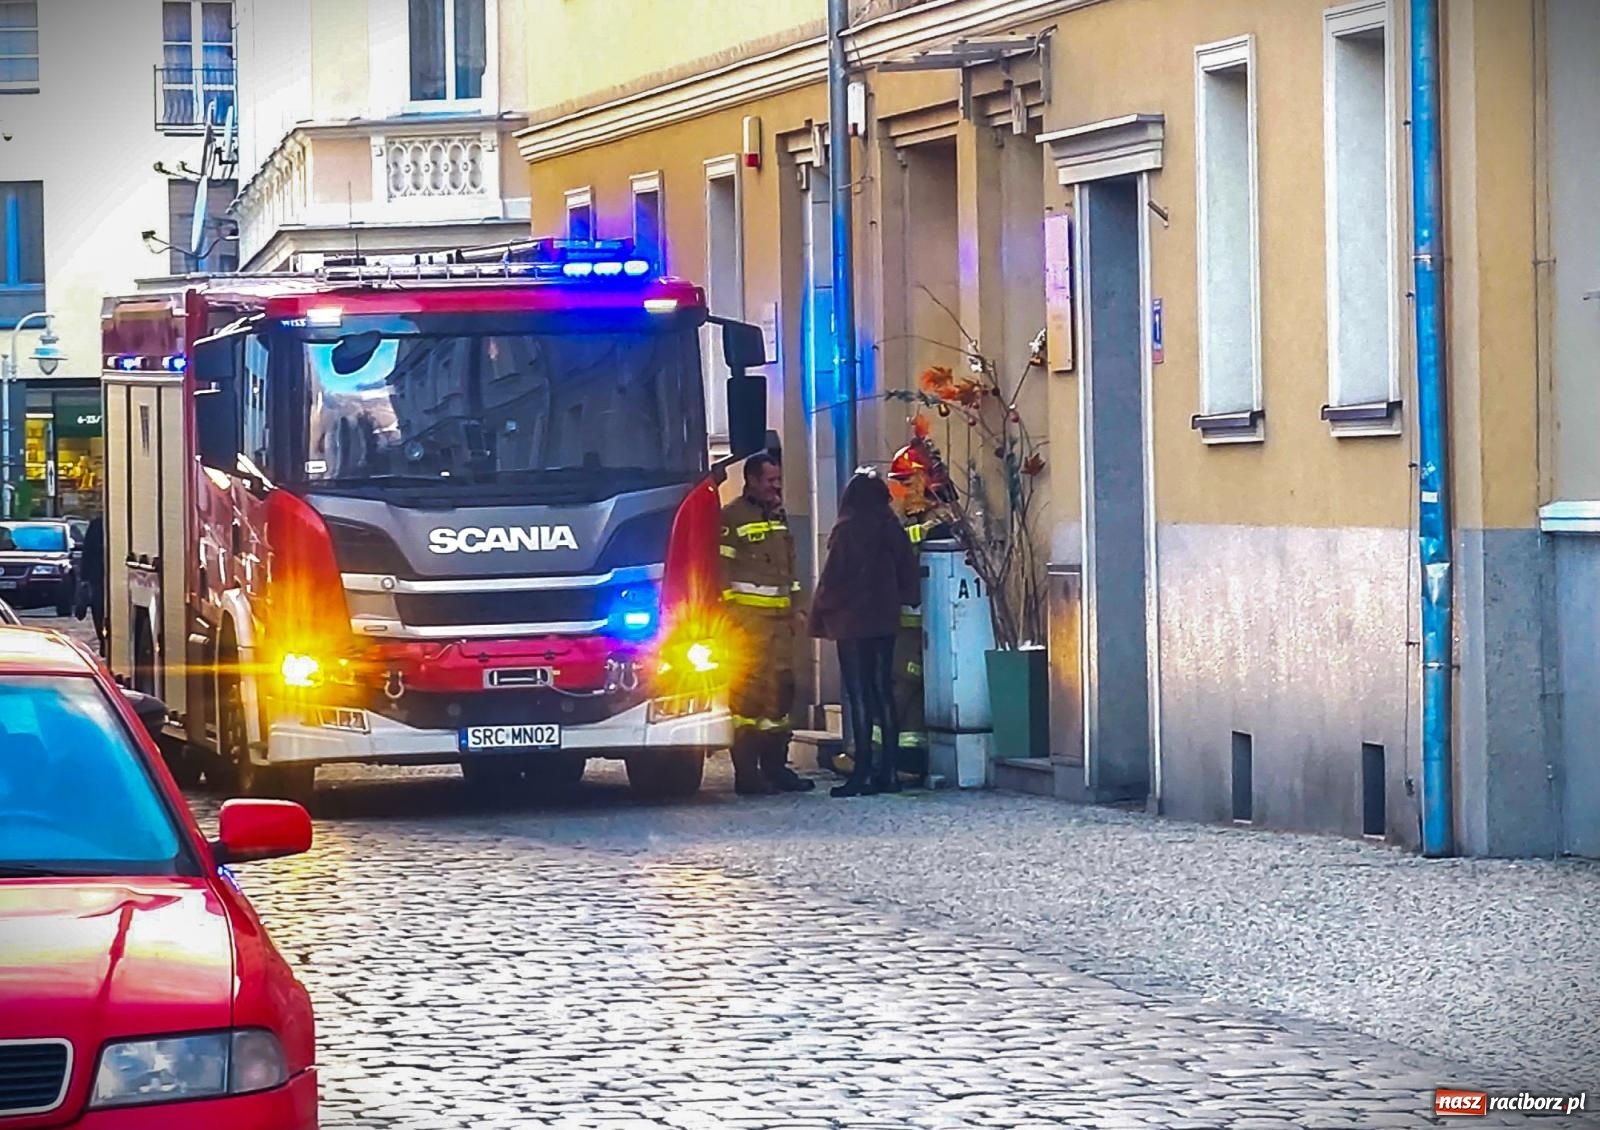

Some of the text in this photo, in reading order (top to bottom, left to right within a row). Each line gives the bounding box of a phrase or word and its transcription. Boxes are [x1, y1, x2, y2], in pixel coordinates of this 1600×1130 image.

[428, 525, 579, 554] SCANIA
[471, 726, 556, 746] SRC MN02
